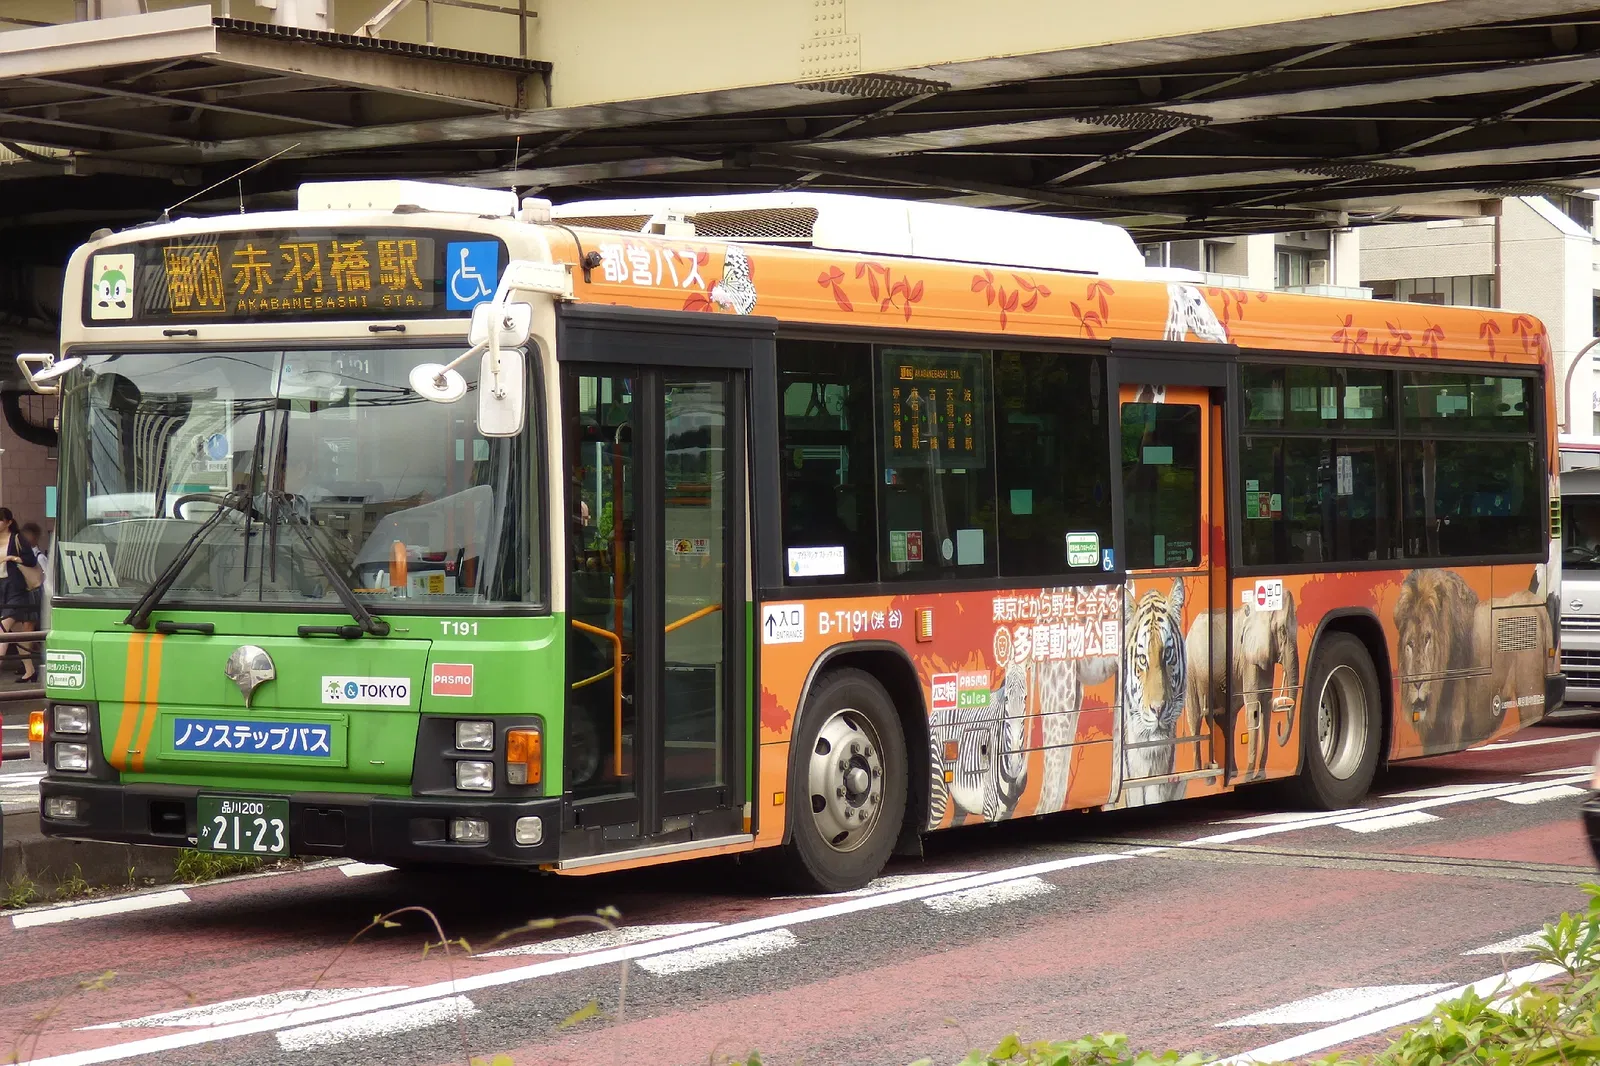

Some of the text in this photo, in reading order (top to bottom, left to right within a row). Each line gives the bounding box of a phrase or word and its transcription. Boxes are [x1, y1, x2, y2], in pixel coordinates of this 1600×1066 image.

[168, 239, 423, 307] 都06 赤羽橋駅
[599, 243, 706, 290] 都営バス
[237, 293, 423, 311] AKABANEBASHI STA.
[64, 549, 113, 587] T191
[993, 592, 1119, 621] 東京だから野生と会える
[440, 621, 479, 636] T191
[779, 610, 800, 627] 入口
[776, 629, 803, 640] ENTRANCE
[1014, 620, 1119, 663] 多摩動物公園
[434, 675, 471, 685] PASMO
[960, 674, 988, 687] PASMO
[346, 683, 407, 698] & TOKYO
[933, 680, 957, 702] バス特
[960, 691, 986, 705] Suica
[175, 723, 329, 753] ノンステップバス
[202, 815, 285, 853] か 21-23
